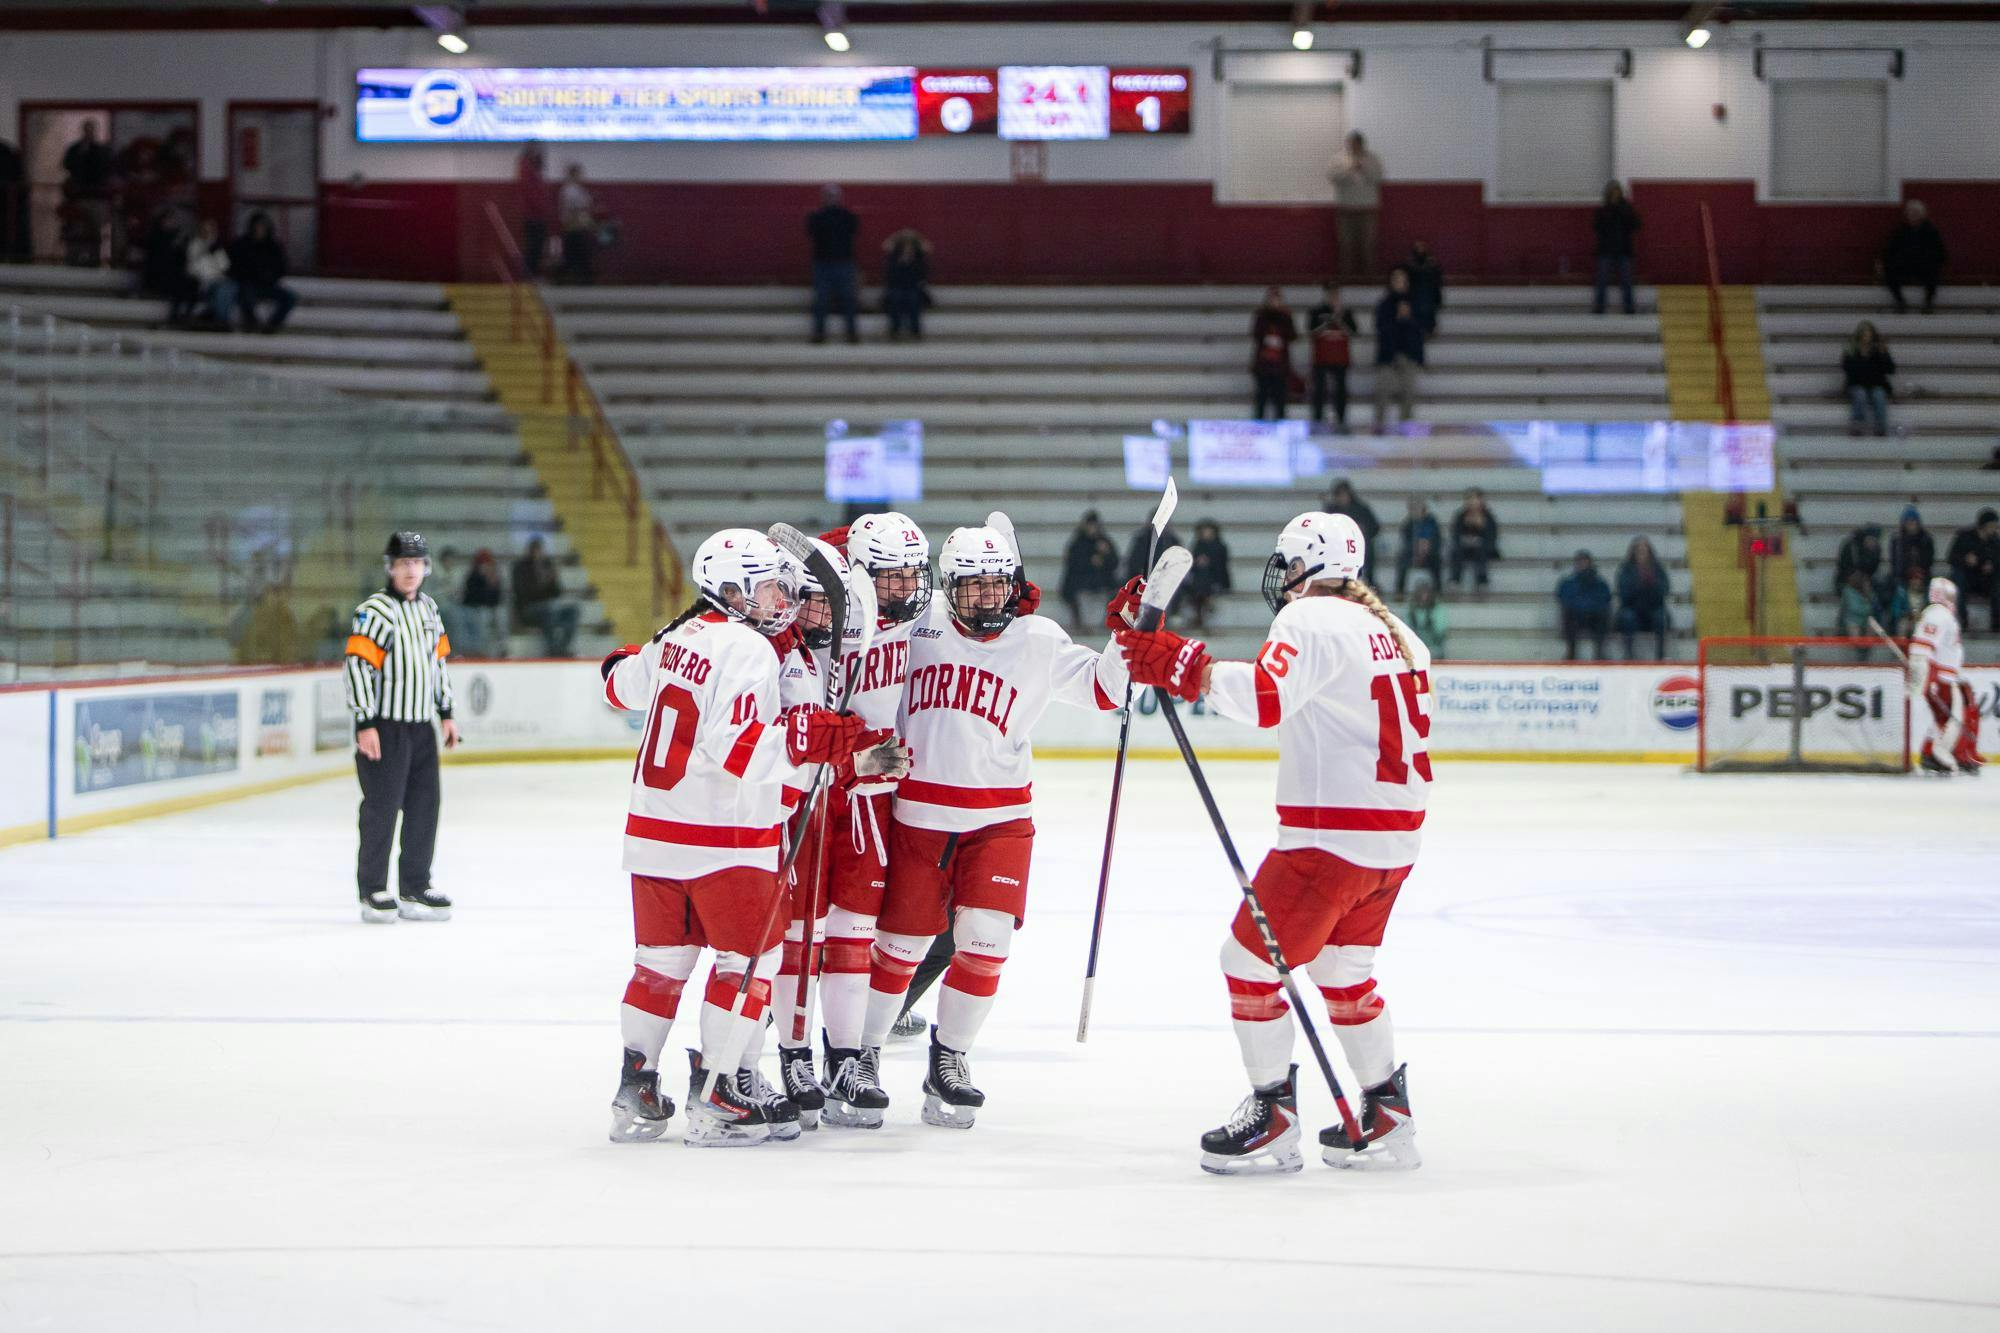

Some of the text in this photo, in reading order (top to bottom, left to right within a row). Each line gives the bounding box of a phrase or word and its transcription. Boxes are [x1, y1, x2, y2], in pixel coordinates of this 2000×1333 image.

[941, 97, 973, 132] 0
[1135, 96, 1161, 131] 1
[864, 520, 873, 529] C
[1301, 519, 1311, 528] C
[902, 530, 919, 542] 24
[724, 540, 734, 549] C
[984, 539, 994, 549] 6
[1346, 539, 1356, 553] 15
[917, 627, 943, 637] ECAC
[837, 640, 908, 698] ORNE
[908, 663, 1018, 737] CORNELL
[1653, 695, 1698, 707] PEPS
[1730, 683, 1883, 720] PEPSI
[729, 692, 760, 726] 10
[796, 710, 808, 752] CC
[1370, 670, 1434, 785] 15
[632, 679, 700, 791] 0
[871, 880, 885, 888] CC
[991, 875, 1020, 886] CCM
[887, 943, 912, 955] CCM
[971, 941, 996, 949] CCM
